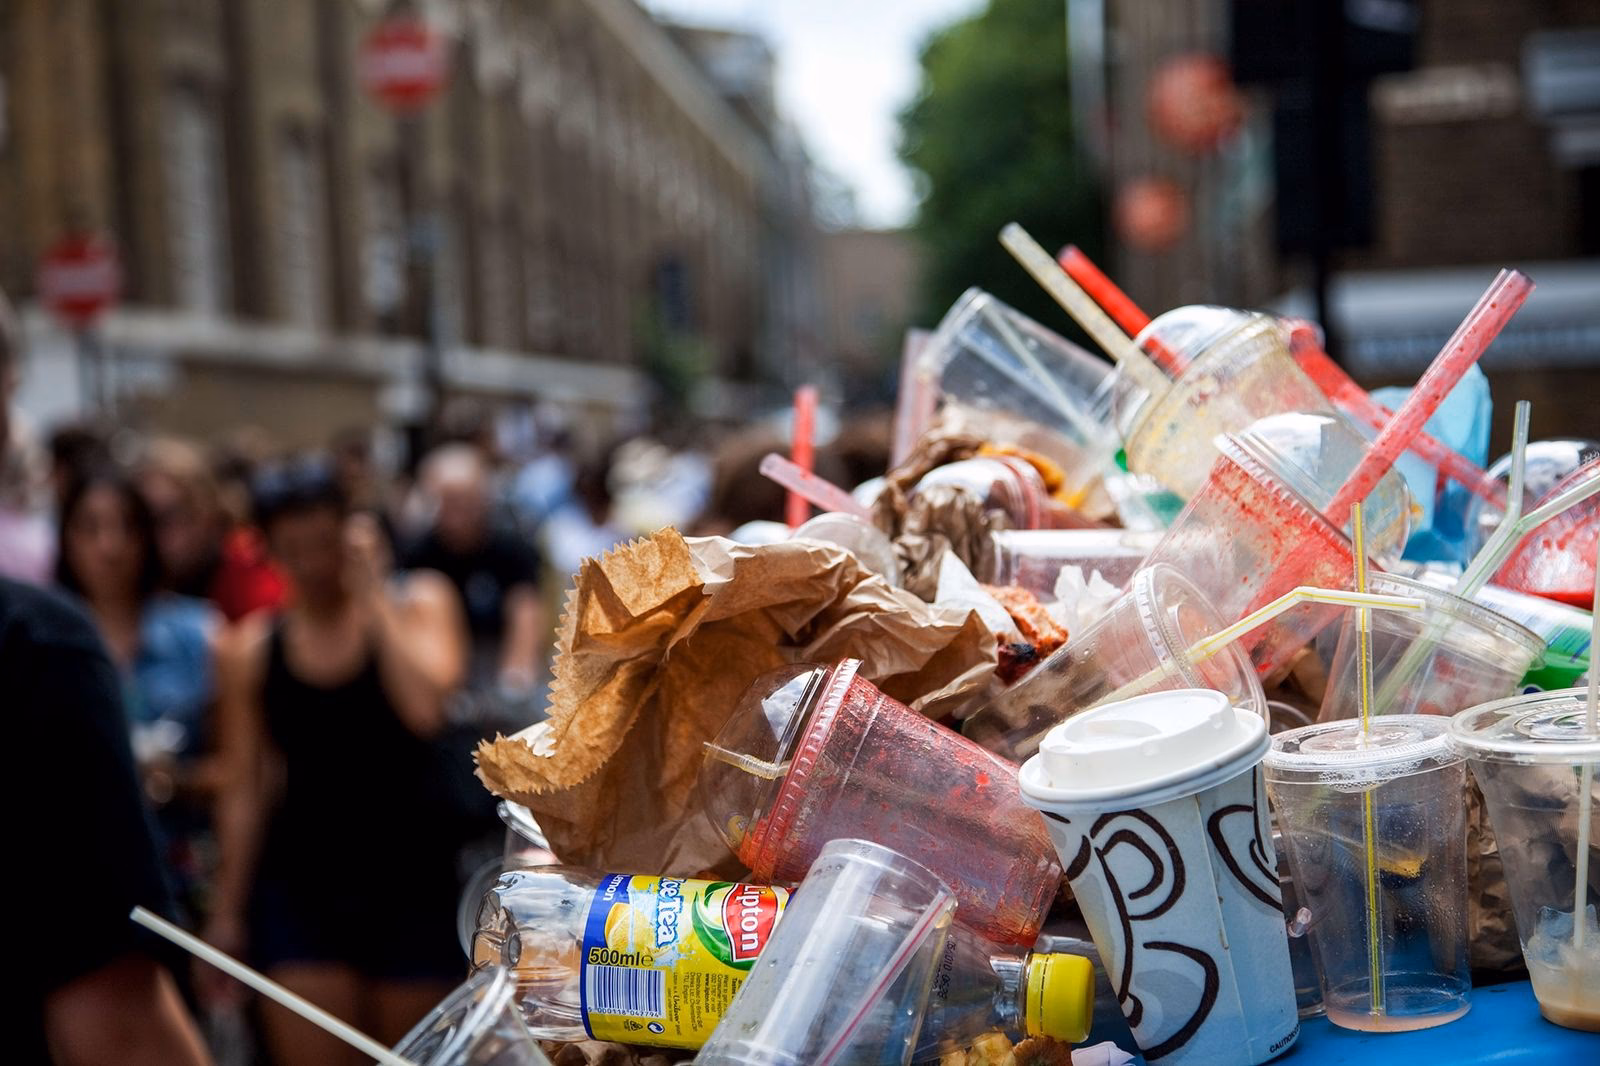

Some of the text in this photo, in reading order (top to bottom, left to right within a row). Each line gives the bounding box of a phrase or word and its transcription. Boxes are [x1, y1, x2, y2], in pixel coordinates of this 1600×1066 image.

[603, 874, 631, 901] Lemon
[657, 896, 683, 946] Tea
[736, 885, 767, 952] Lipton
